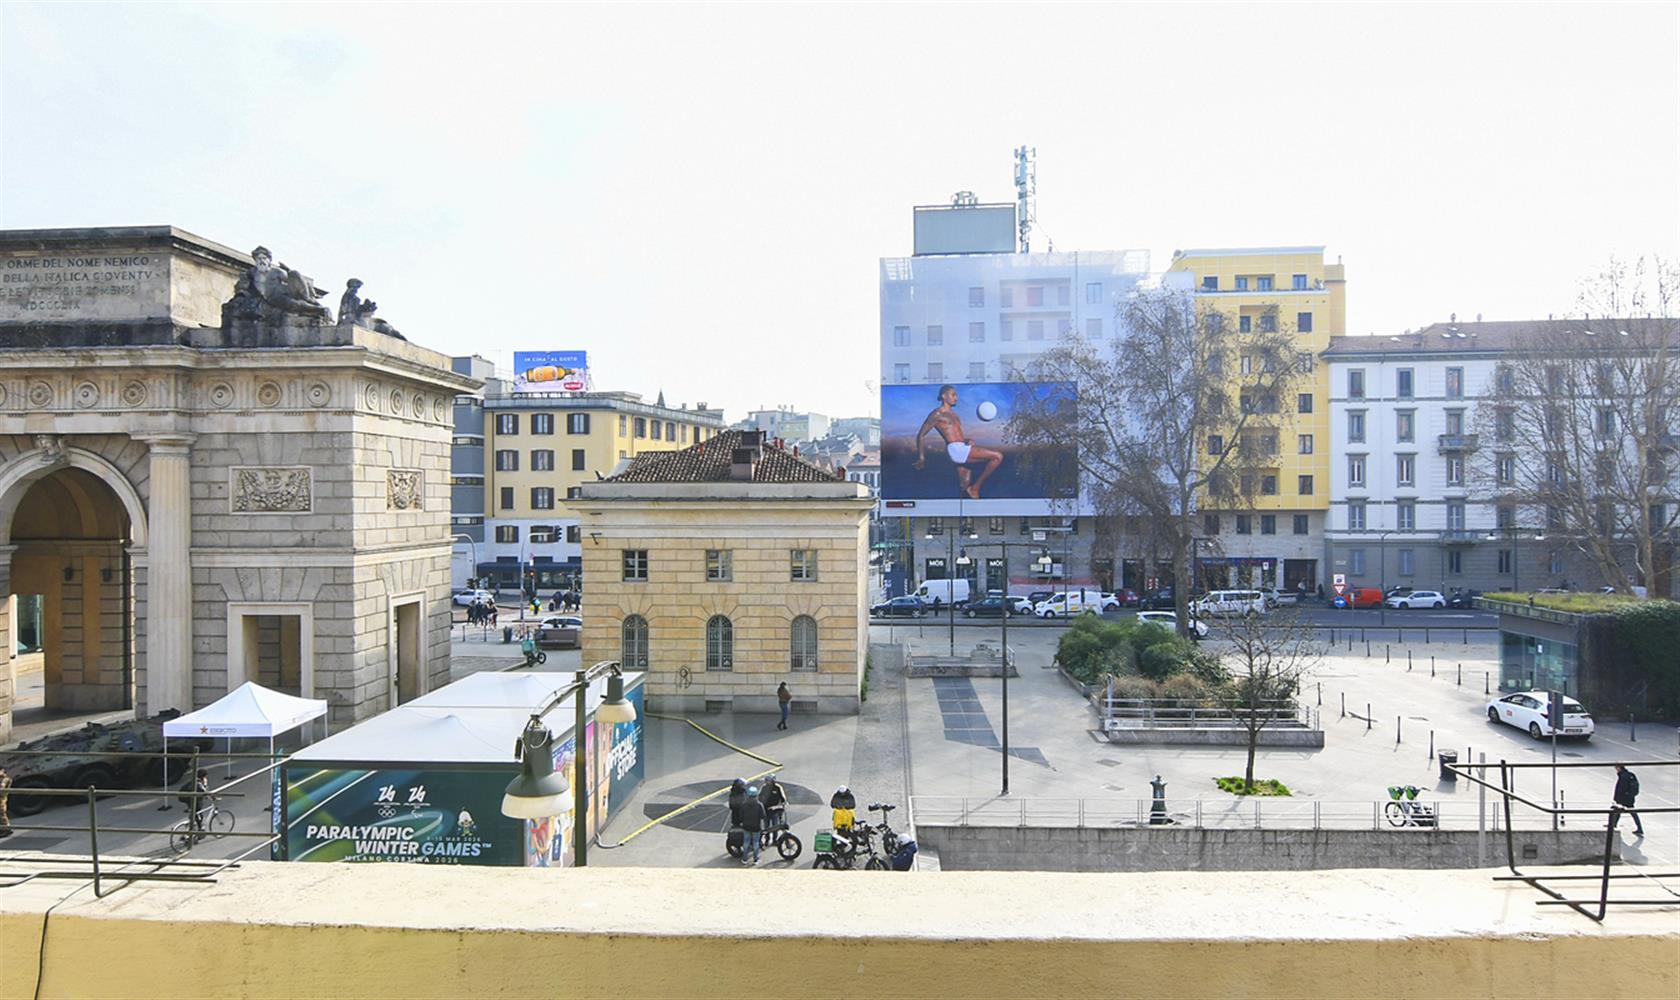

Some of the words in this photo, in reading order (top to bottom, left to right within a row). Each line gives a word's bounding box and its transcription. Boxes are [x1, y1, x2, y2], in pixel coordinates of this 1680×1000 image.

[7, 258, 40, 269] ORME
[42, 258, 64, 268] DEL
[66, 257, 101, 268] NOME
[104, 256, 149, 267] NEMICO
[3, 273, 40, 283] DELLA
[306, 825, 415, 841] PARALYMPIC
[355, 840, 420, 855] WINTER
